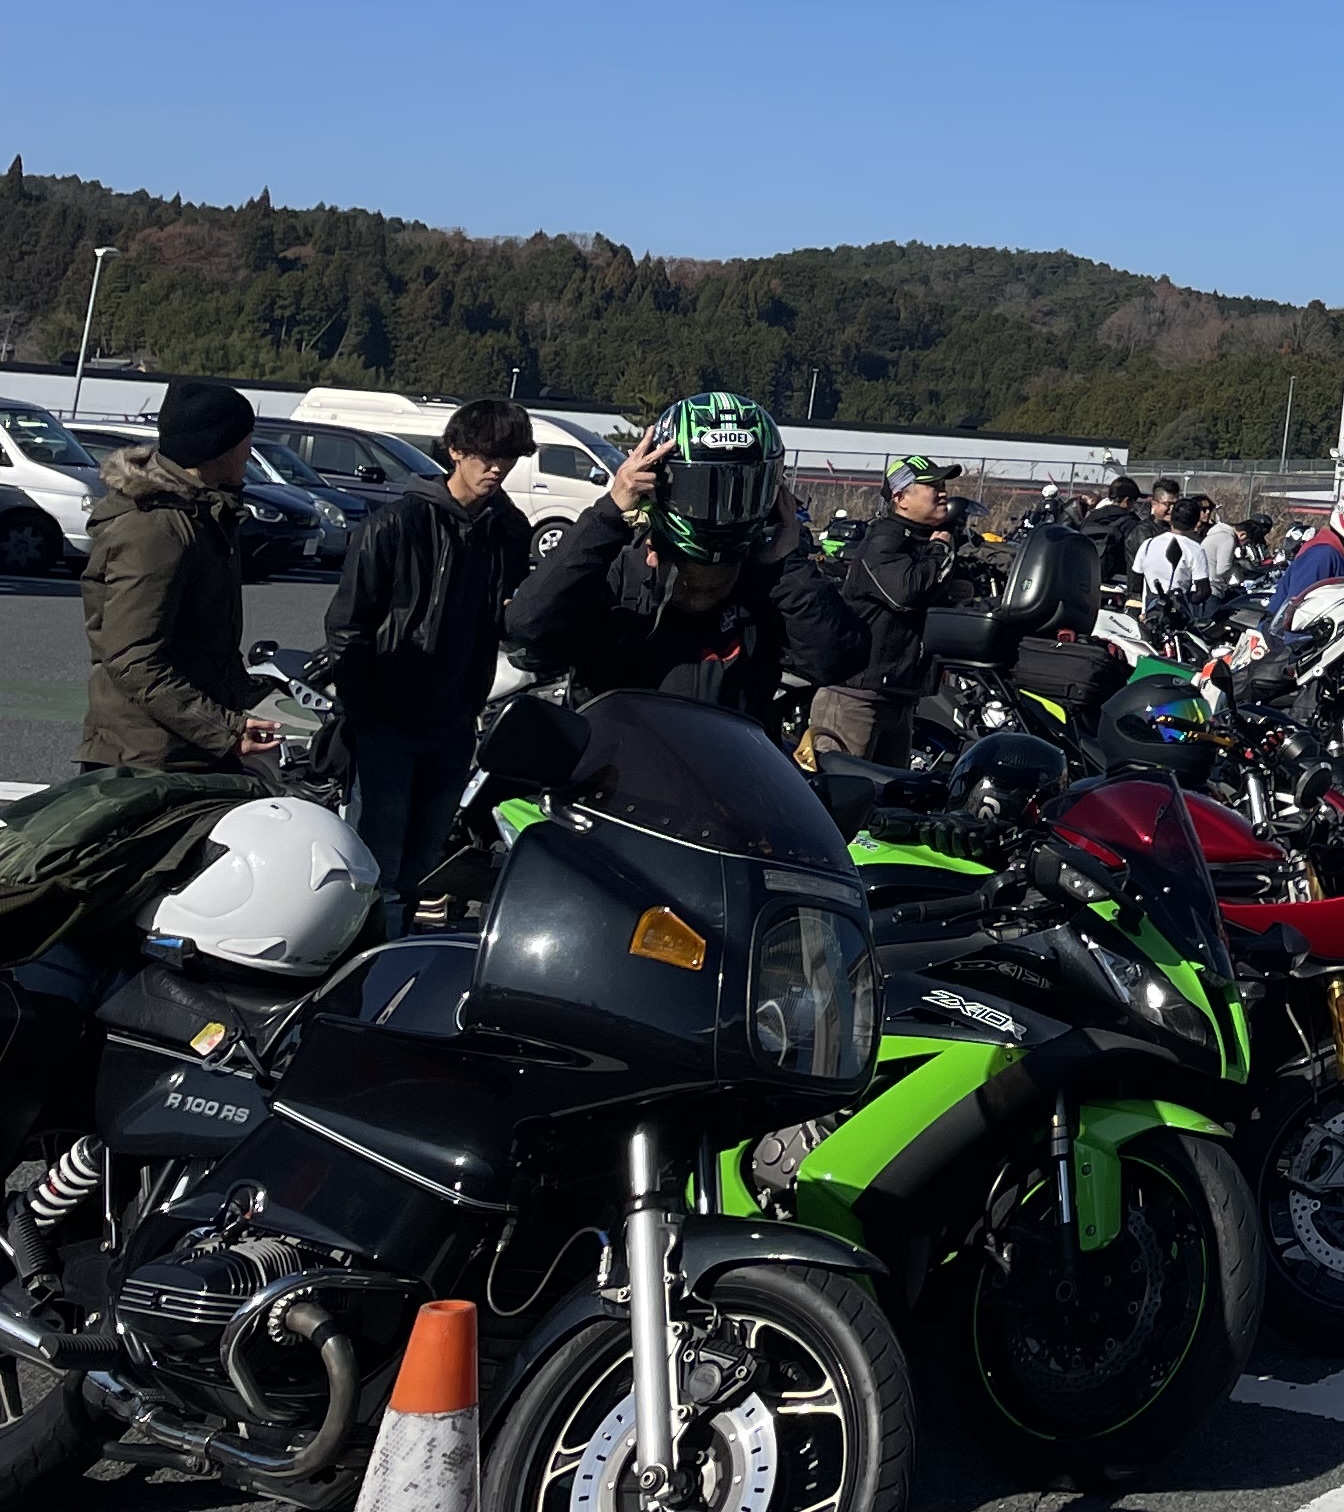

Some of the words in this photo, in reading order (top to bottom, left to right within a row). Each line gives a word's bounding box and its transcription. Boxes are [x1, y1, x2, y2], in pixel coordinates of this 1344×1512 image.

[710, 432, 748, 444] SHOEI
[164, 1092, 183, 1109] R
[183, 1096, 220, 1117] 100
[218, 1104, 250, 1124] RS
